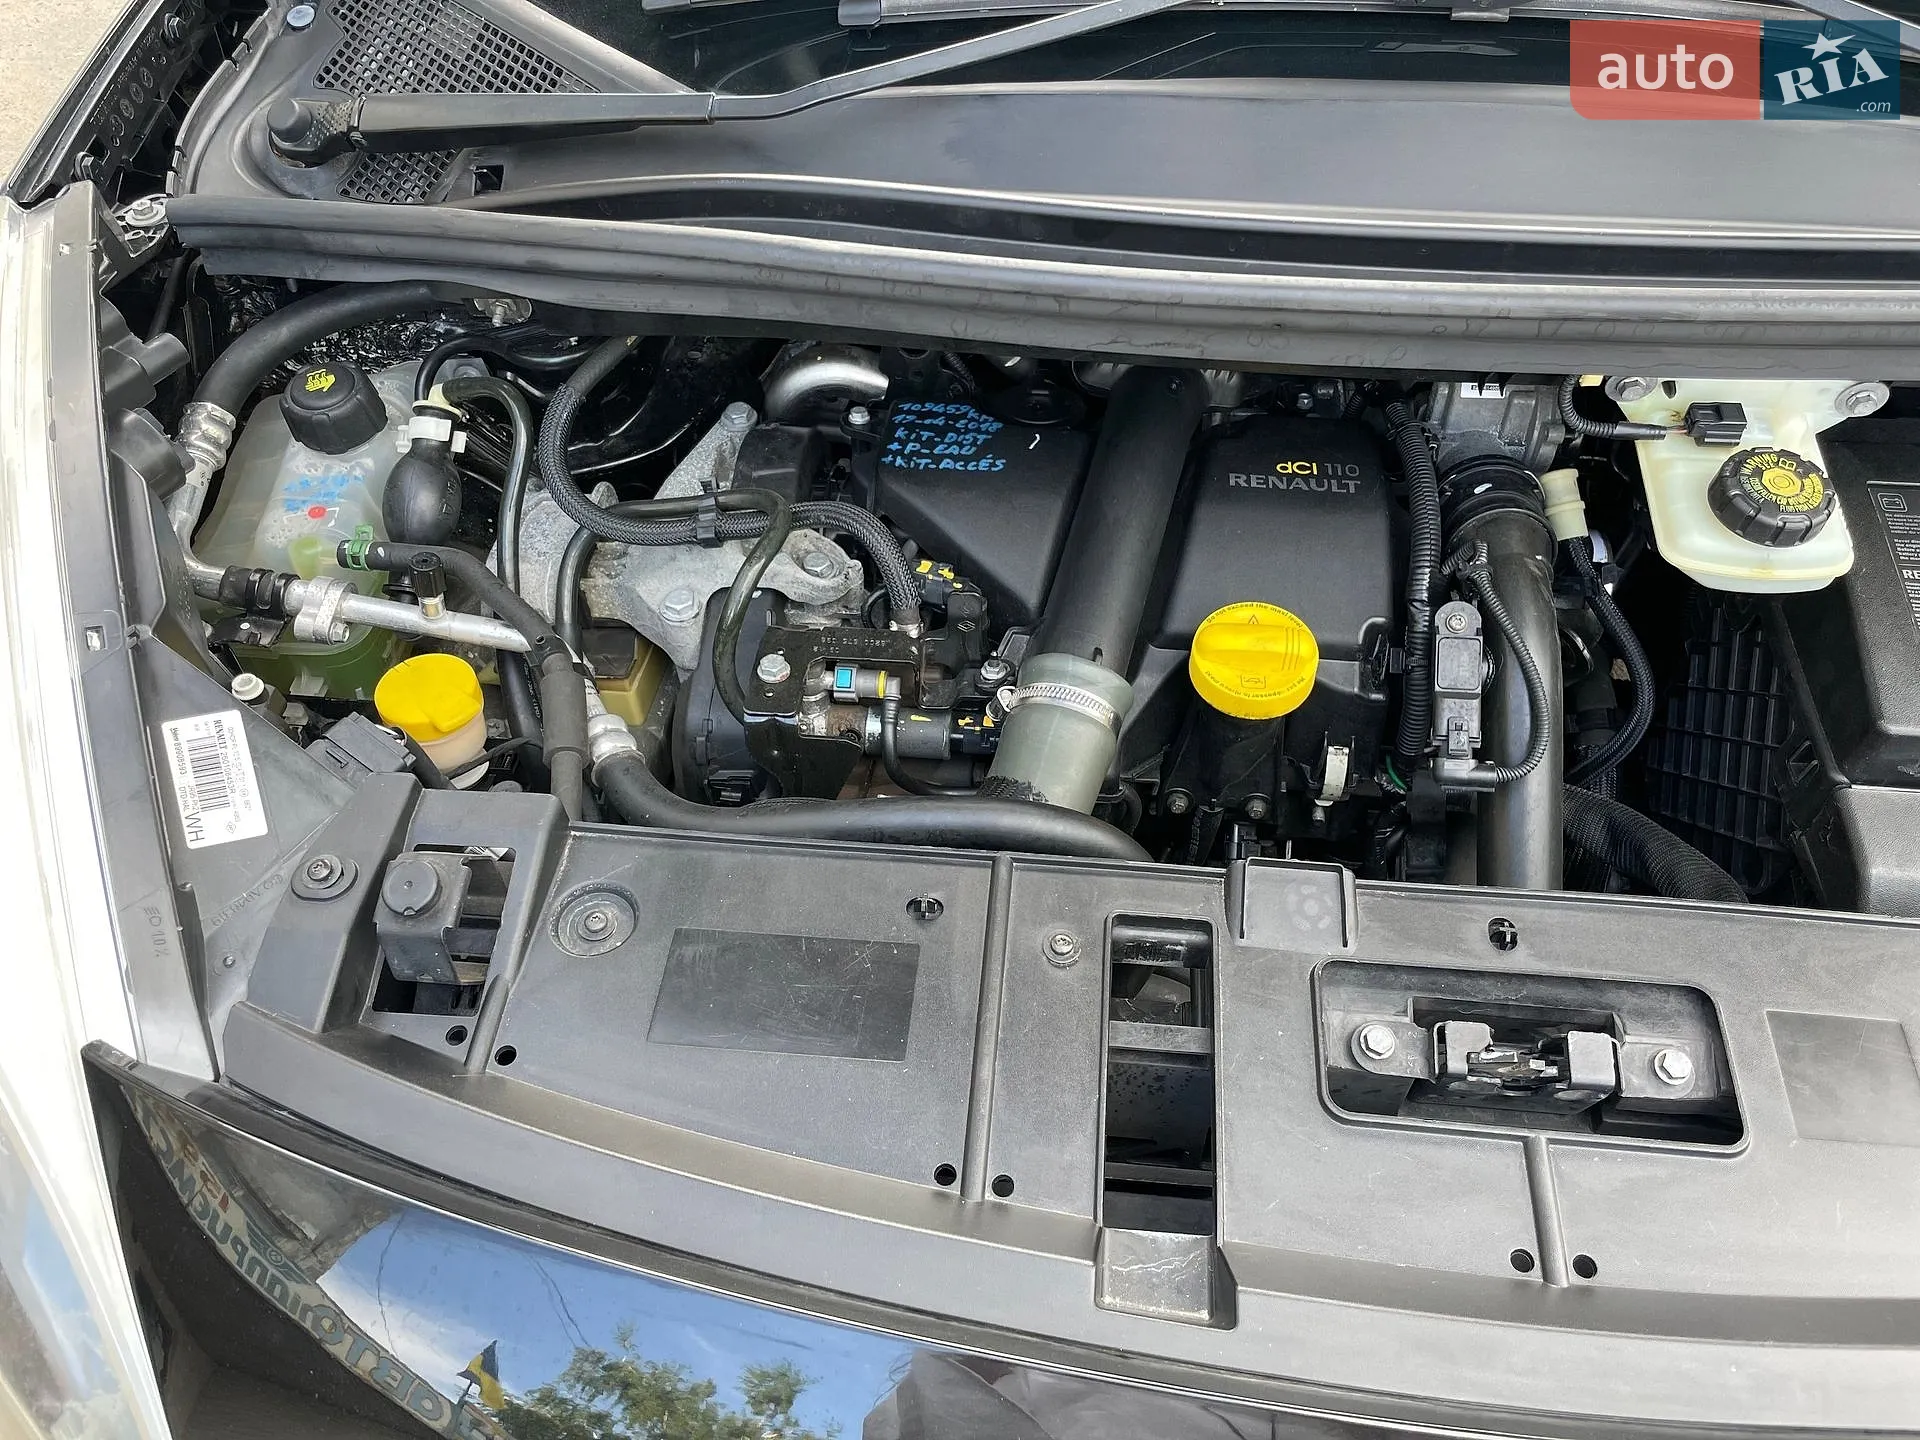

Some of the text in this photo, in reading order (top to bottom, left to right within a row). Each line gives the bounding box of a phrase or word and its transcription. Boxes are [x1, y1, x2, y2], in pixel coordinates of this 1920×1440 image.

[1324, 463, 1360, 477] 110
[1740, 453, 1778, 475] WARNING
[1229, 472, 1361, 494] RENAULT
[212, 718, 227, 750] RENAULT
[183, 811, 205, 843] WH
